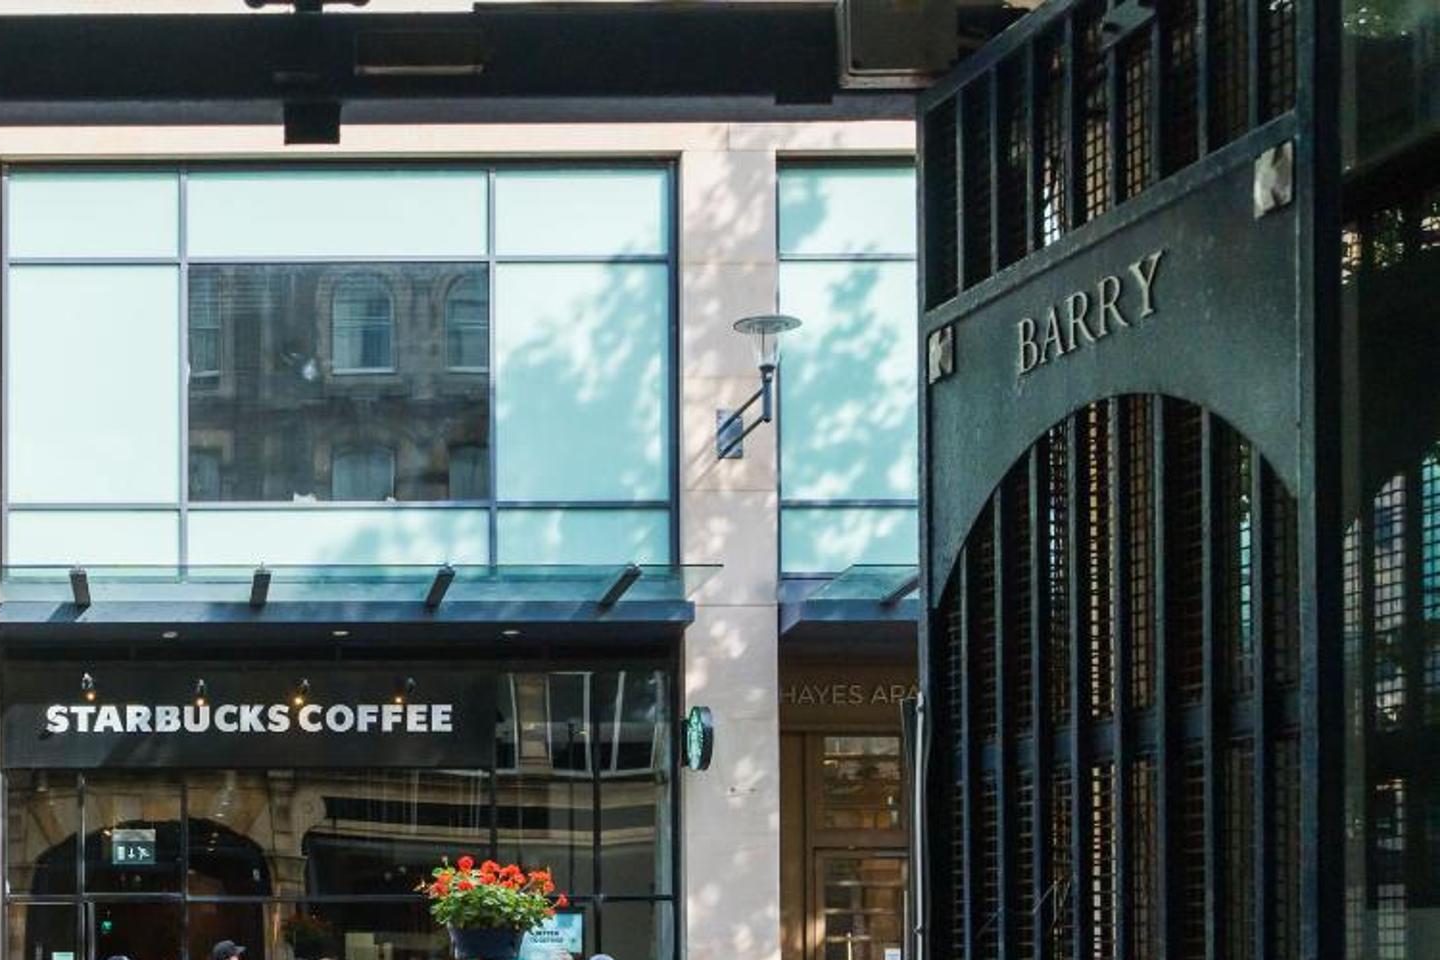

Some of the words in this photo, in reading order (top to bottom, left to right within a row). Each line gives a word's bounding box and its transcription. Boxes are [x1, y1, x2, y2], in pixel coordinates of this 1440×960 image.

[1017, 250, 1163, 373] BARRY
[779, 684, 862, 704] HAYES
[46, 703, 290, 733] STARBUCKS
[298, 703, 453, 733] COFFEE
